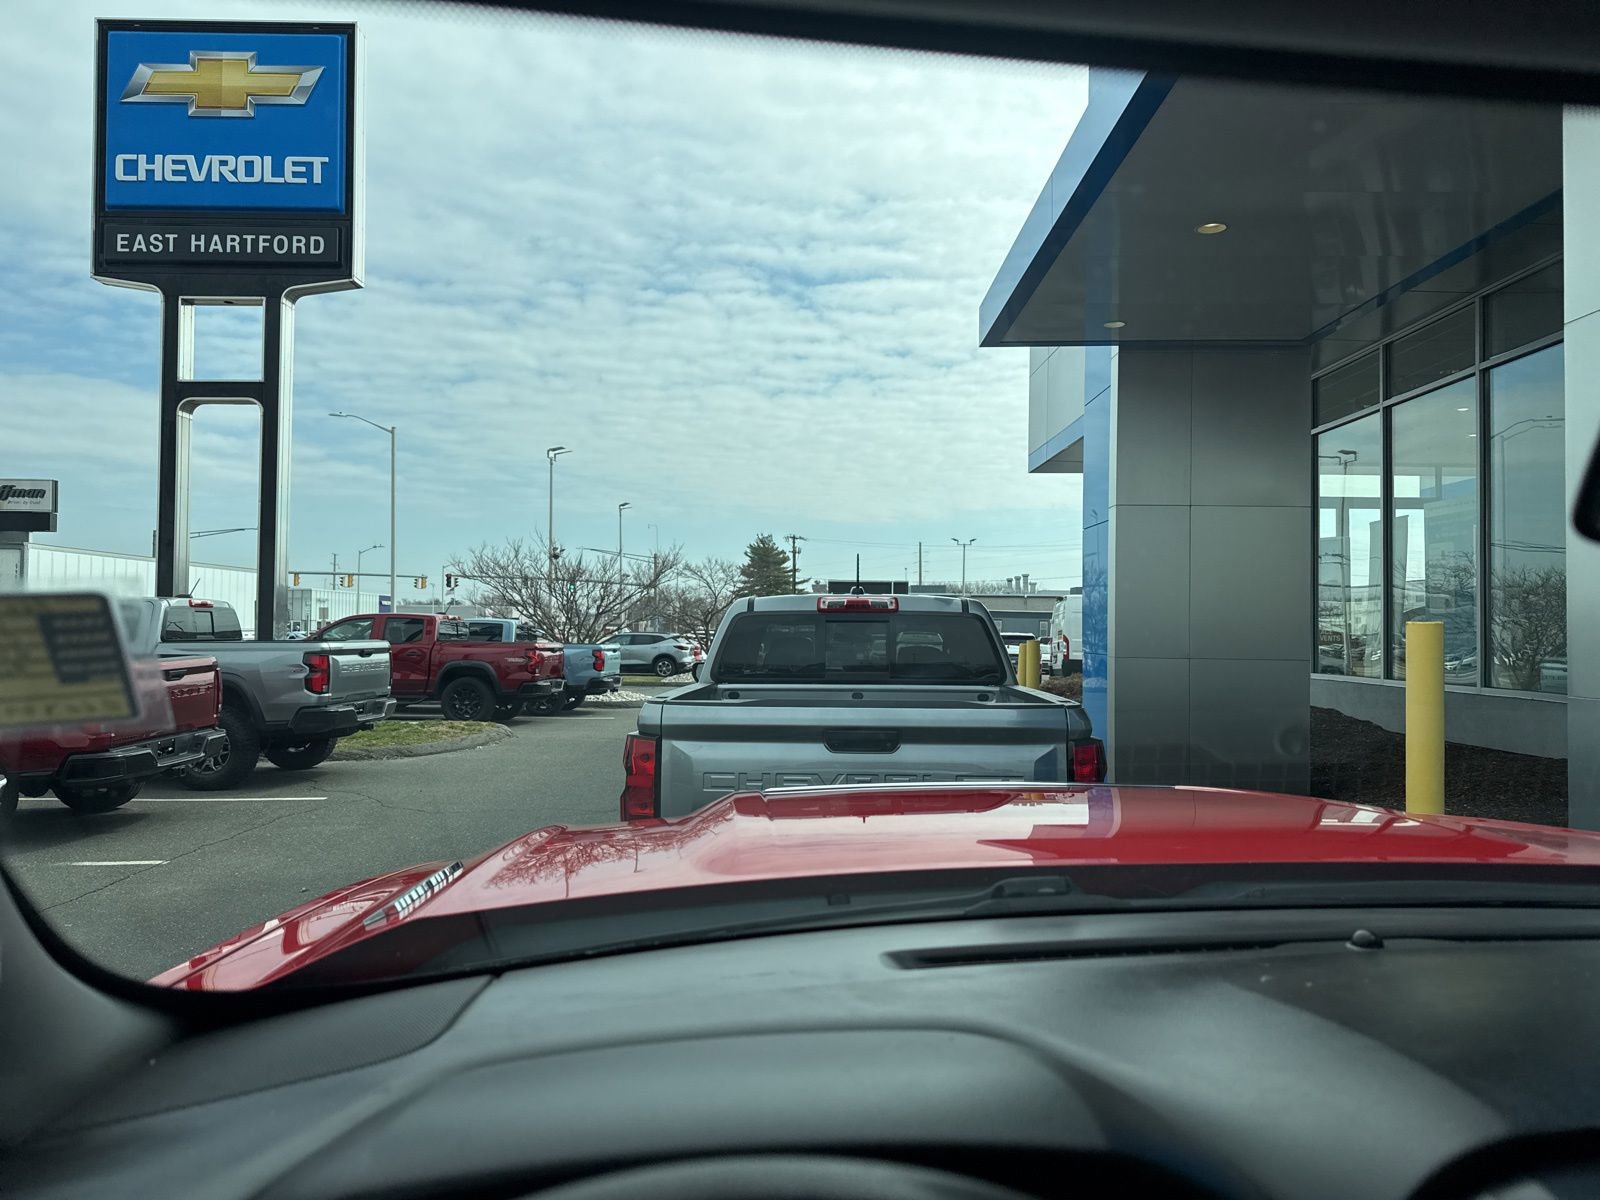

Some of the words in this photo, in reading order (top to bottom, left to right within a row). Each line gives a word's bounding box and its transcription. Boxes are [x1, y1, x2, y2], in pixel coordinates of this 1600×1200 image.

[115, 154, 329, 184] CHEVROLET
[116, 233, 178, 252] EAST
[191, 234, 325, 255] HARTFORD
